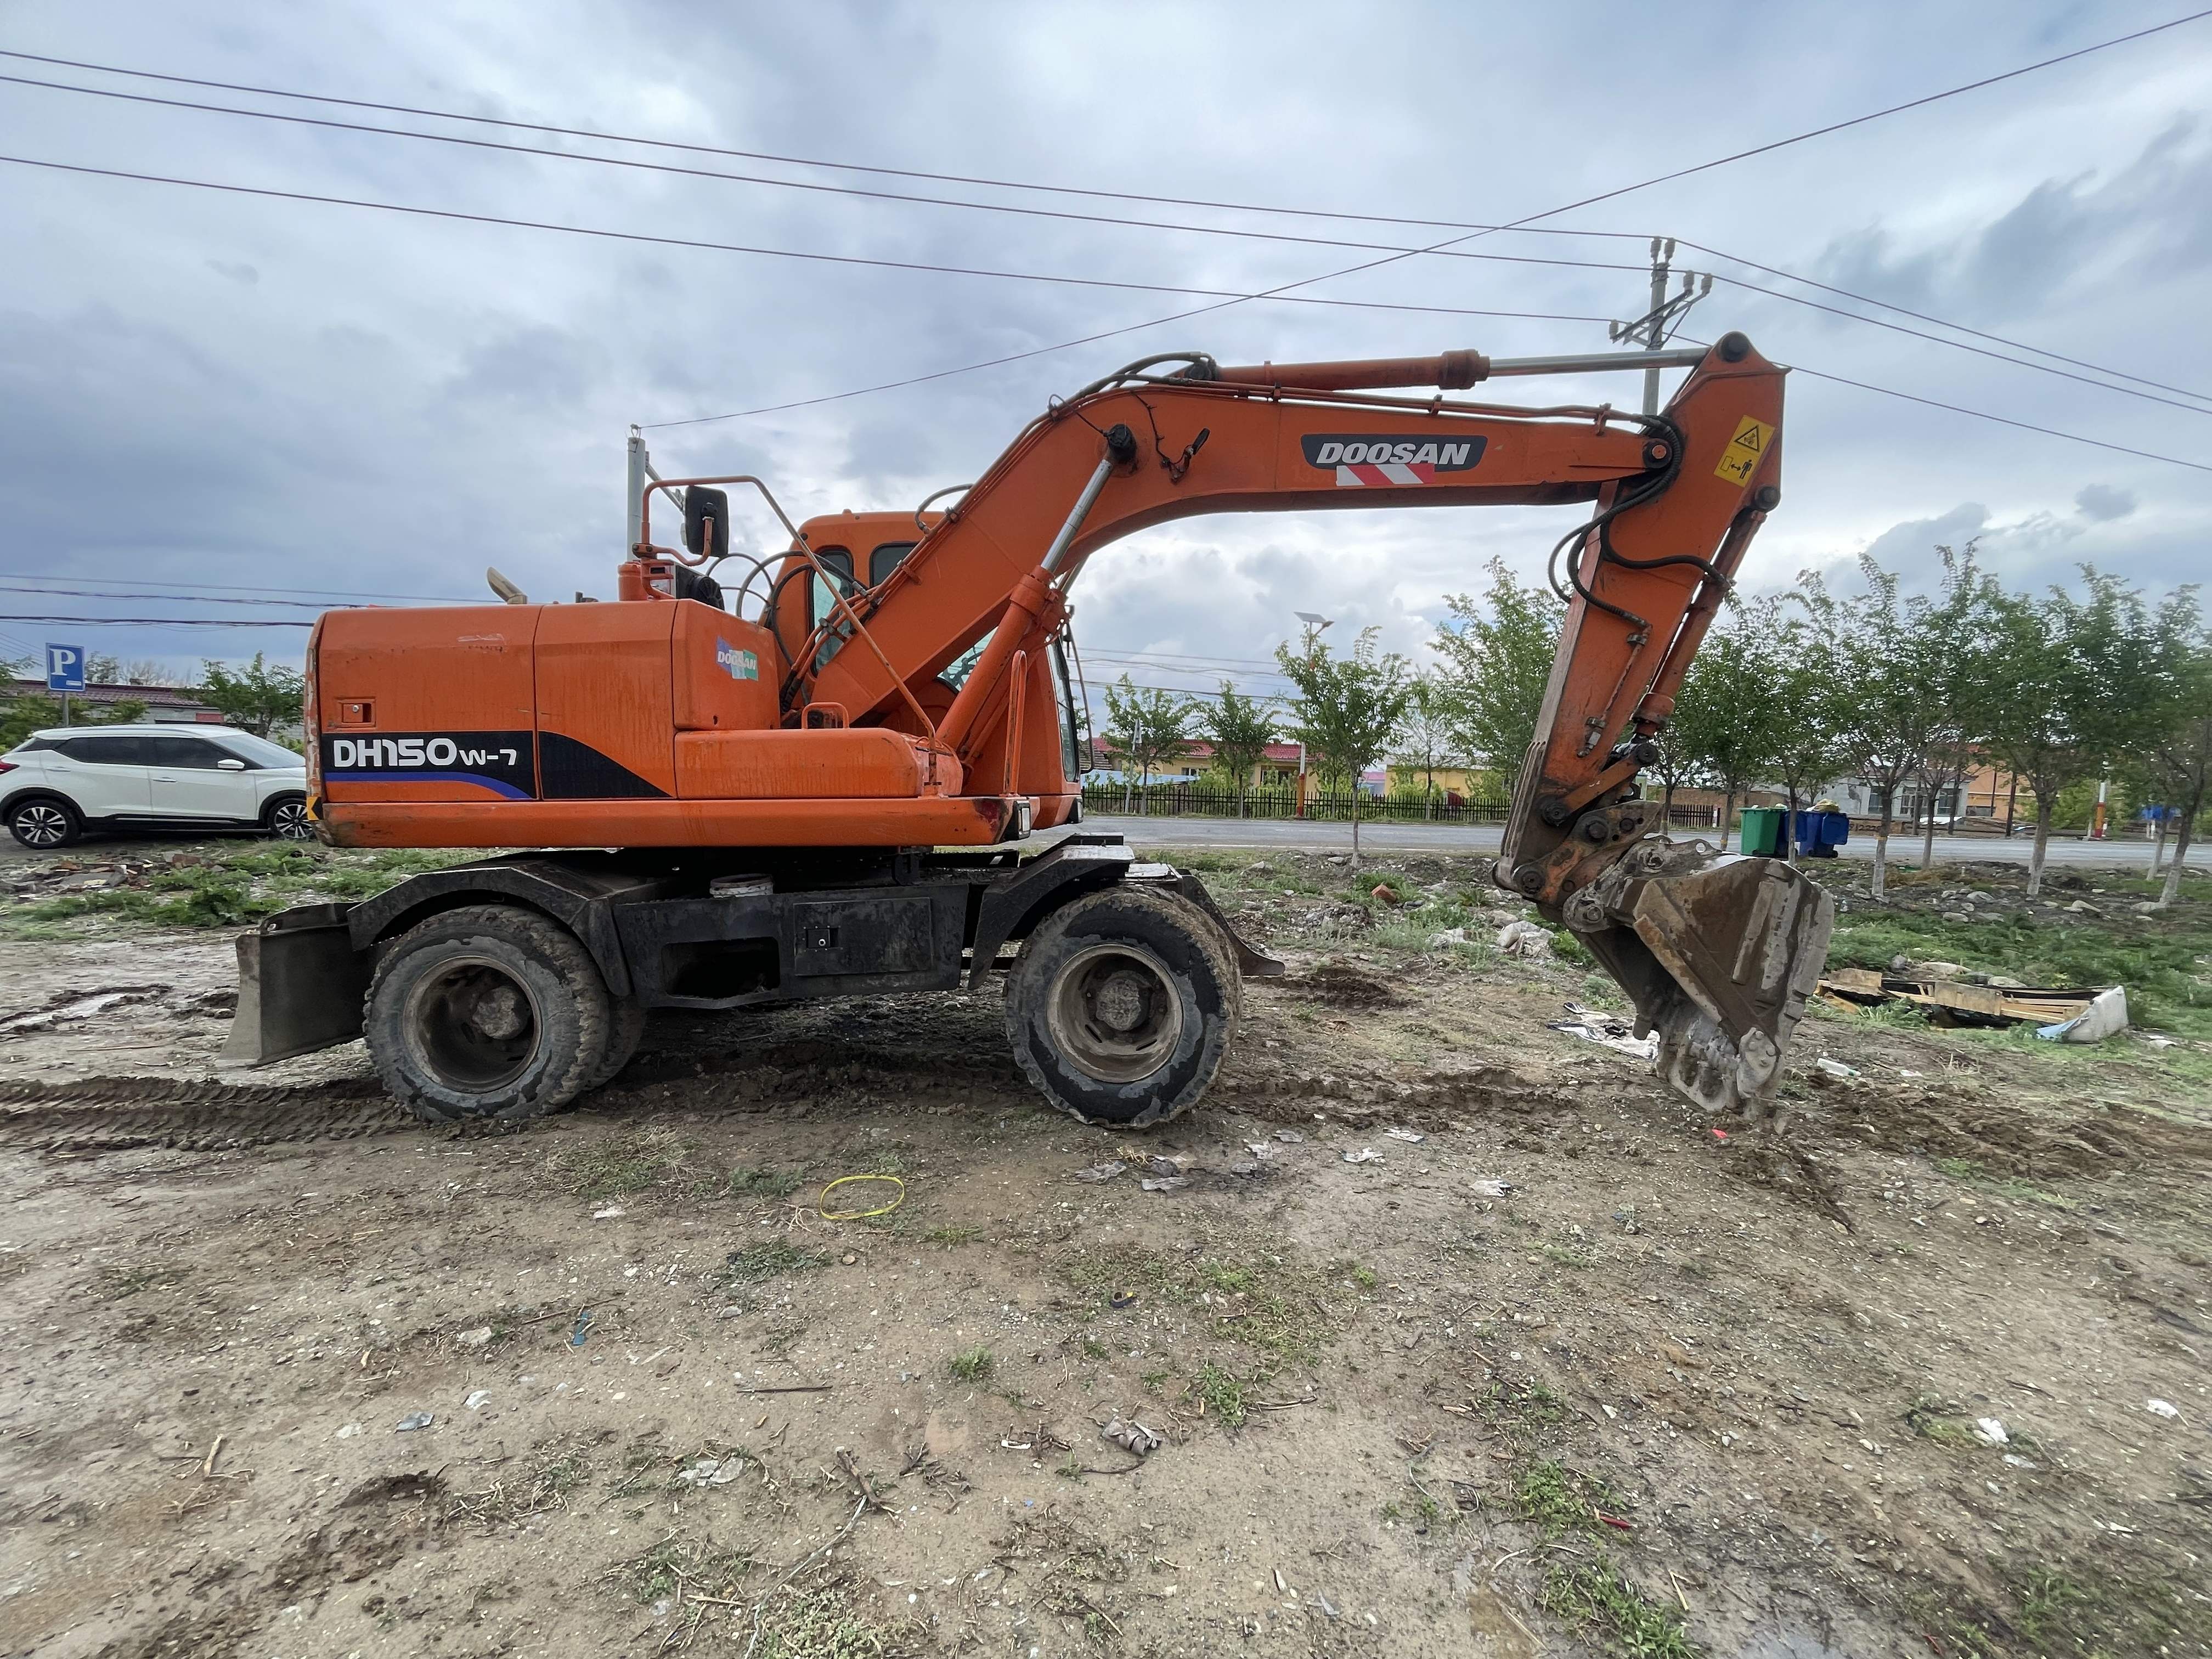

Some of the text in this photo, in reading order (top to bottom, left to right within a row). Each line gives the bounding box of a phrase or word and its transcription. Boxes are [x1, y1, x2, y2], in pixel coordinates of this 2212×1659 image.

[1316, 443, 1471, 465] DOOSAN
[49, 648, 76, 676] P
[717, 651, 756, 670] DOOSAN
